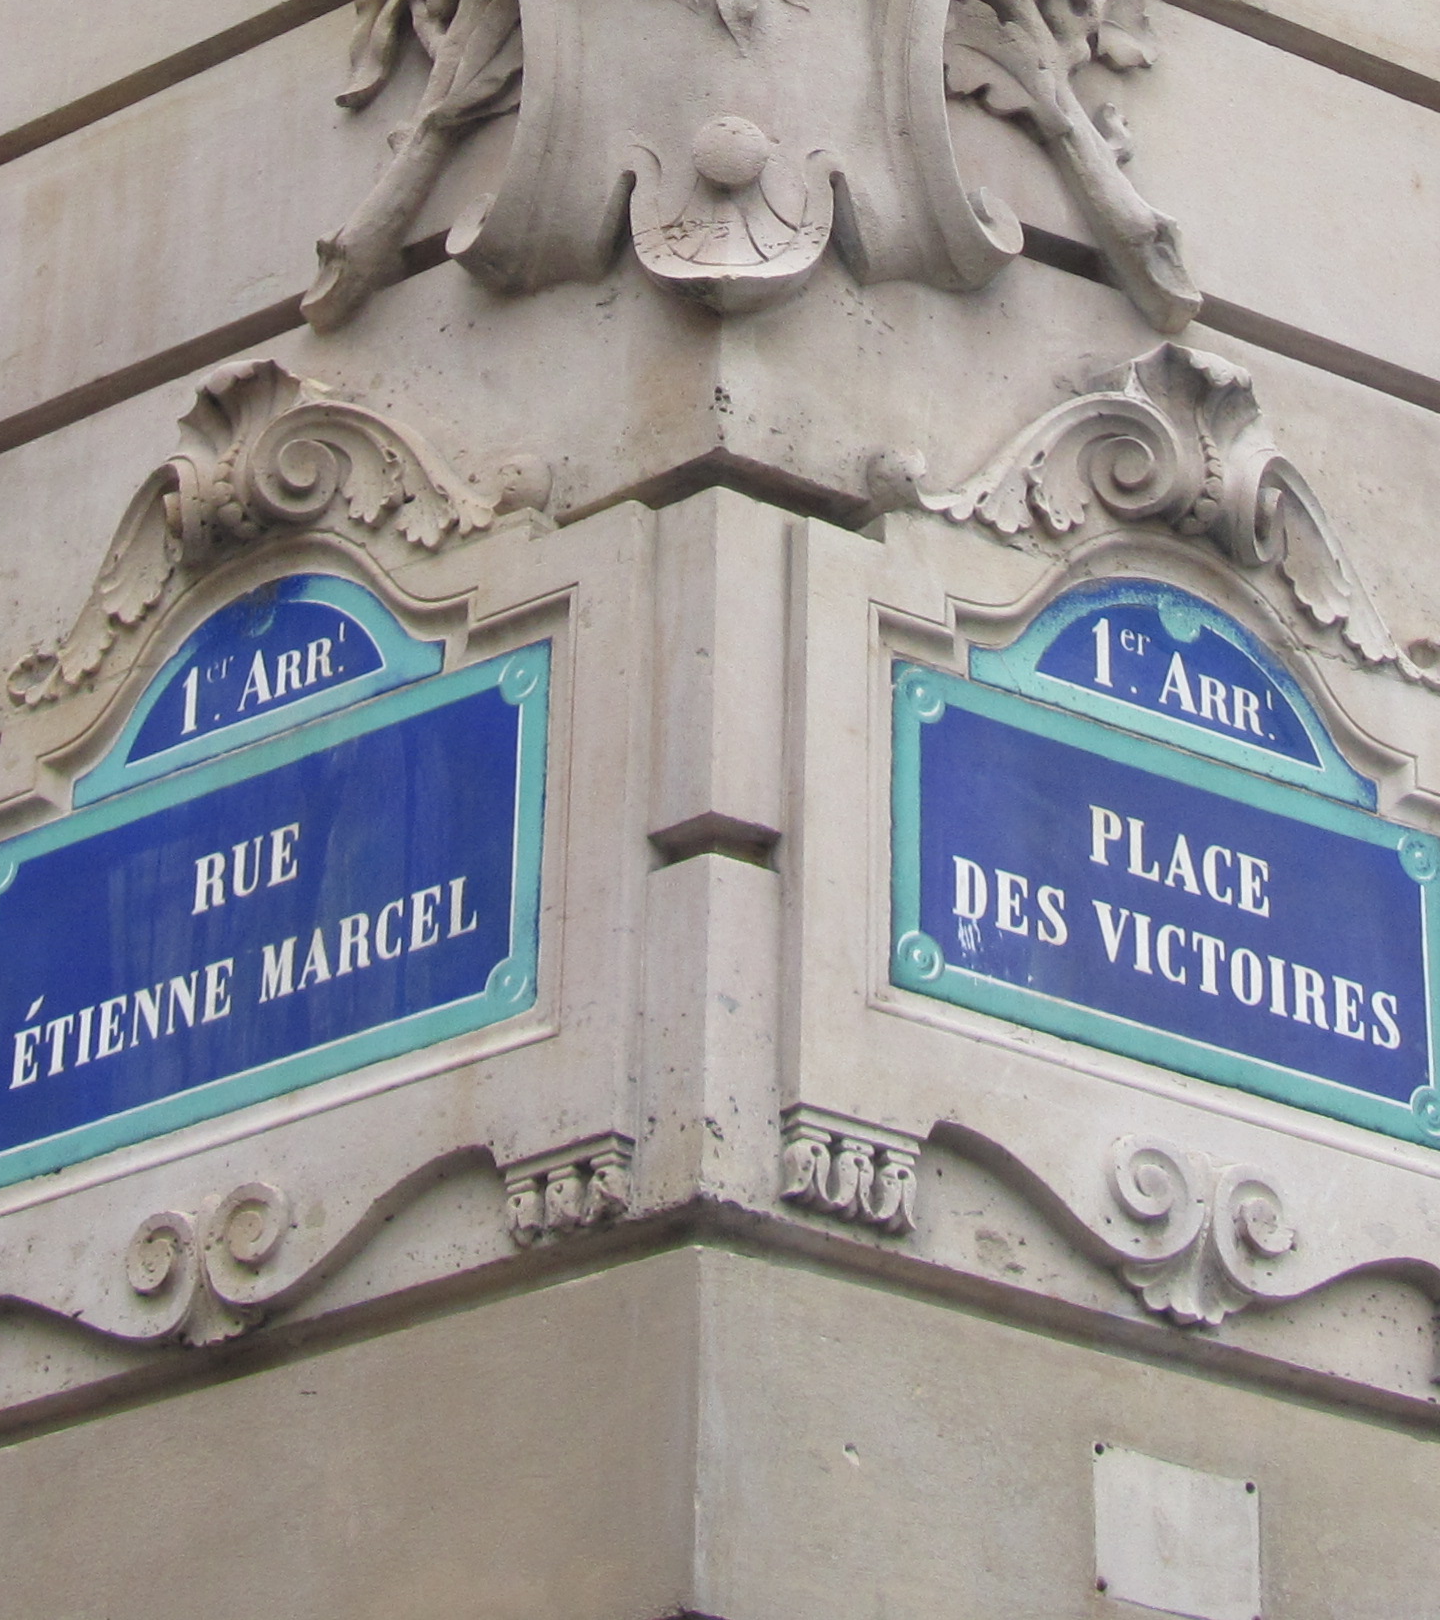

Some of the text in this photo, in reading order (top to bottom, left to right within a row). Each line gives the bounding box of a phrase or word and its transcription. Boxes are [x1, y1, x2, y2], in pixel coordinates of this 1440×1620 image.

[191, 821, 300, 916] RUE
[1089, 804, 1271, 918] PLACE
[8, 875, 477, 1090] ÉTIENNE MARCEL
[952, 855, 1401, 1050] DES VICTOIRES
